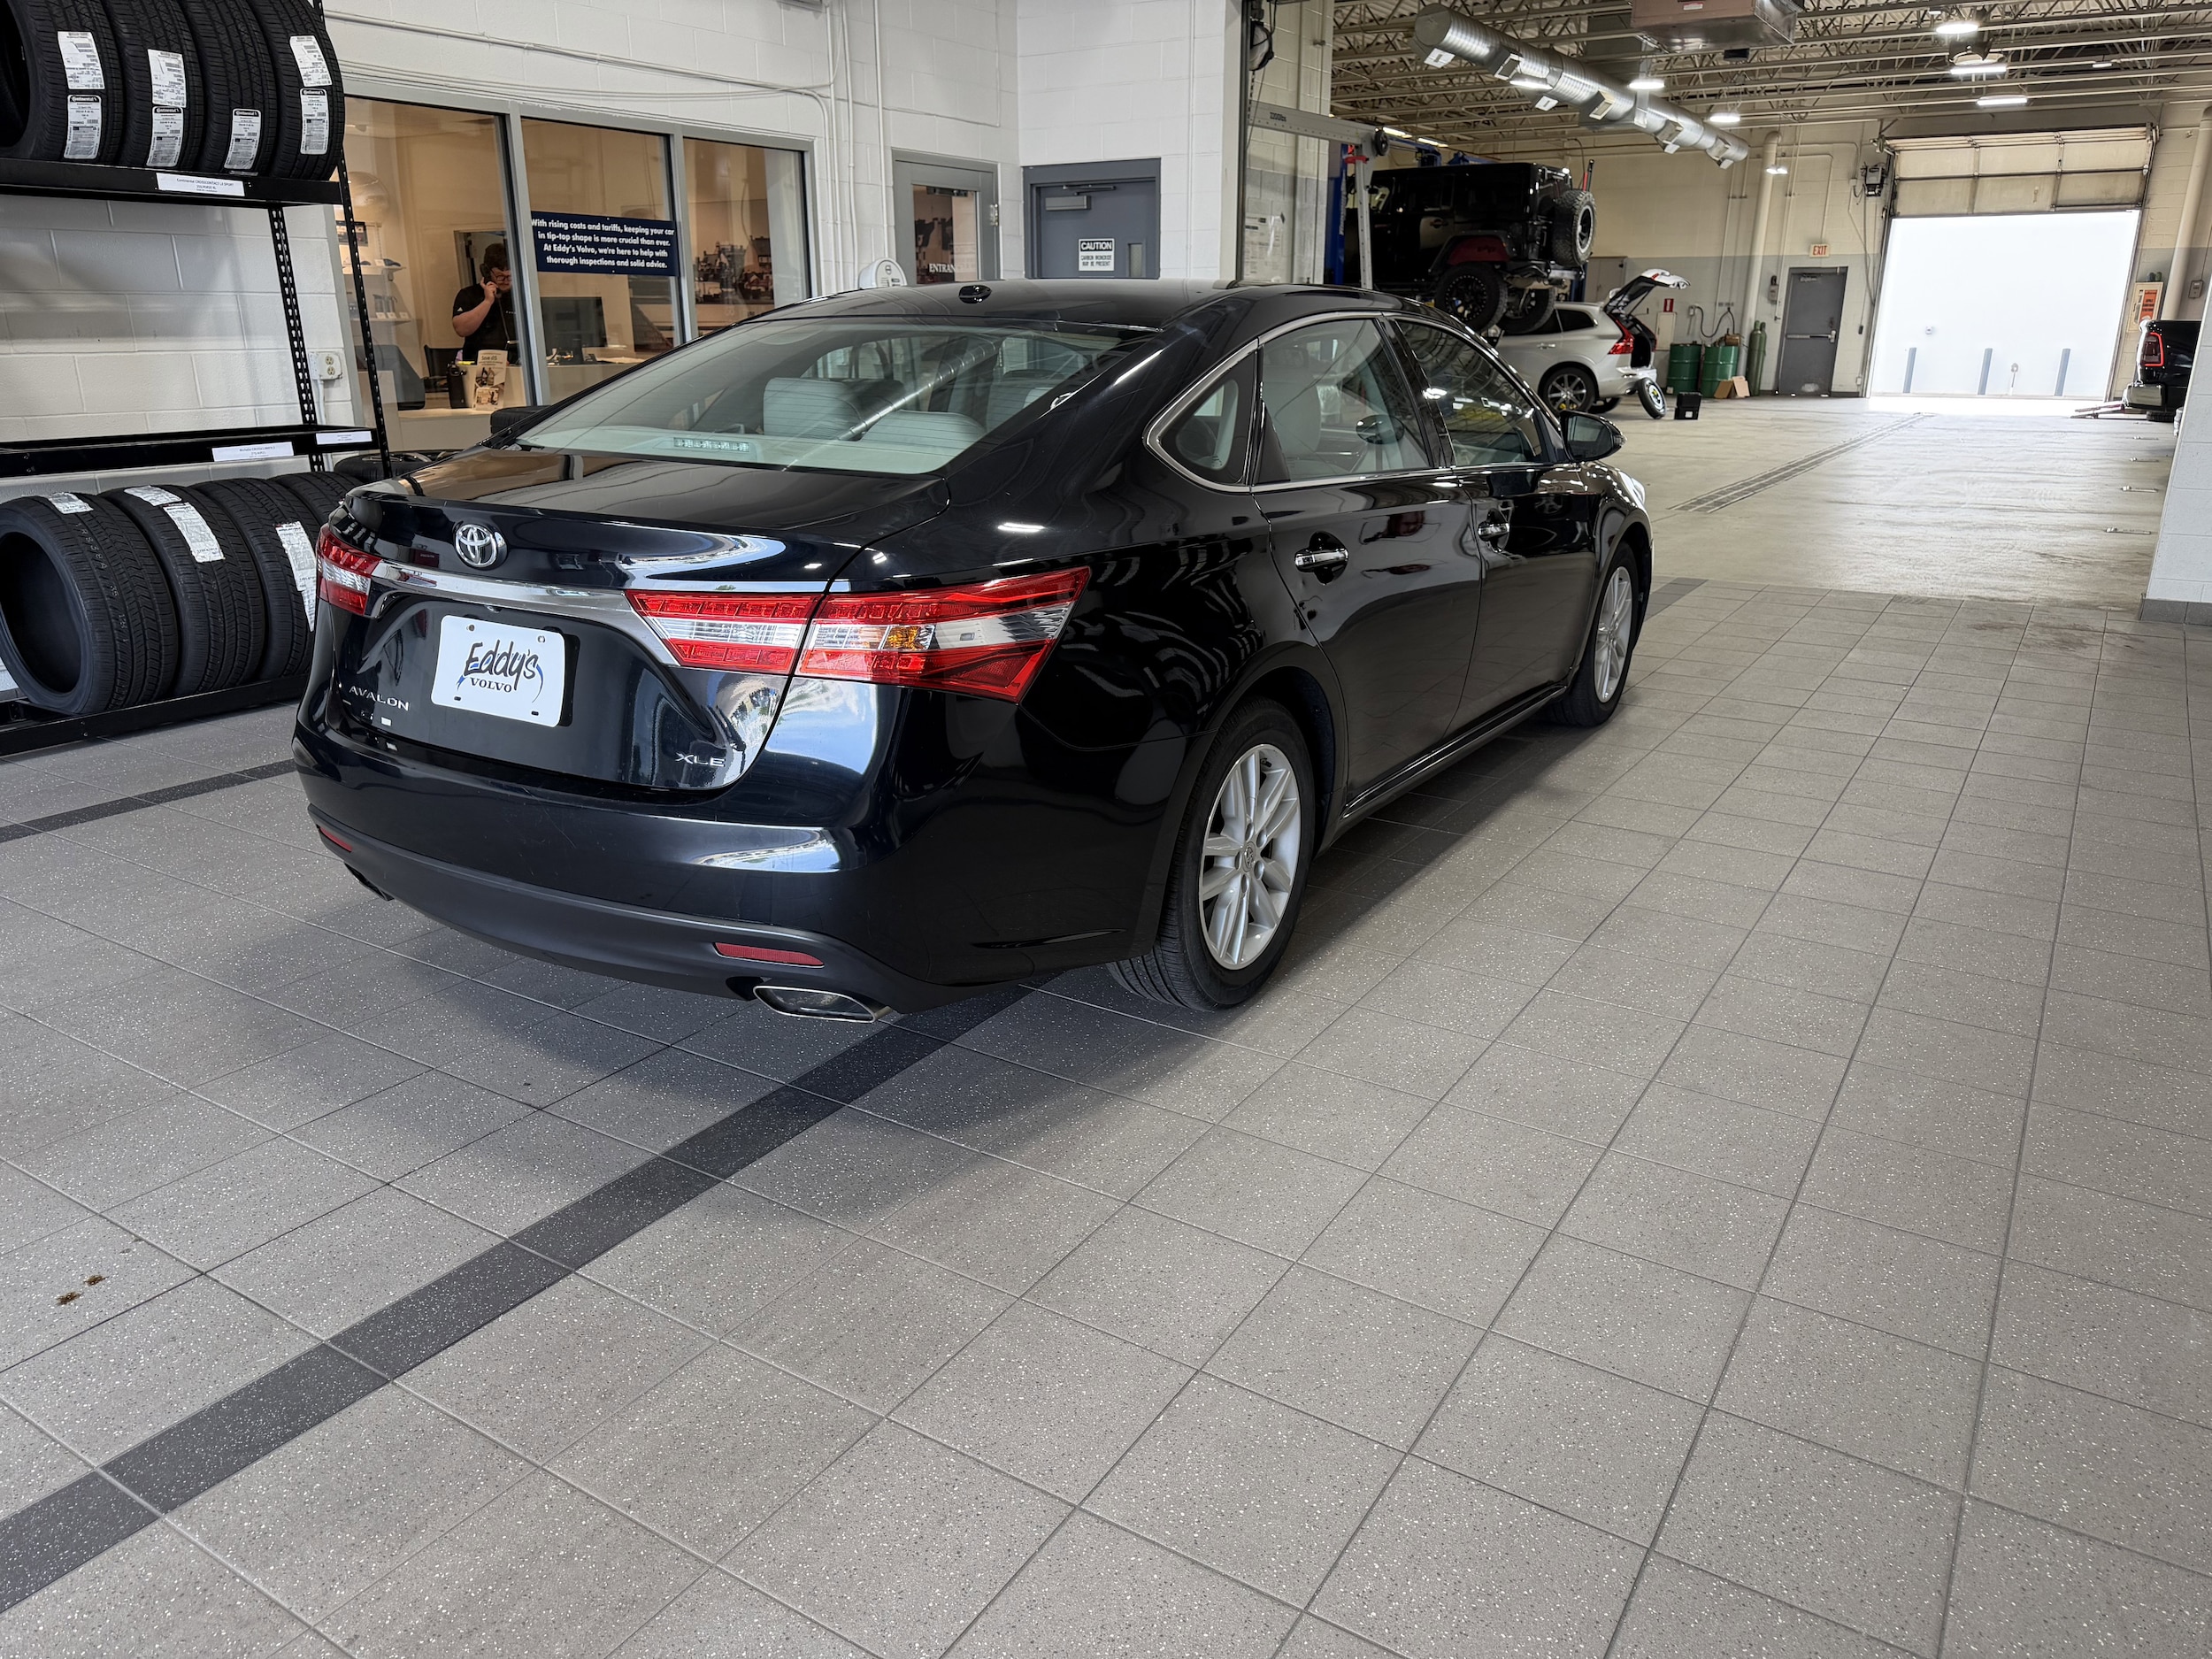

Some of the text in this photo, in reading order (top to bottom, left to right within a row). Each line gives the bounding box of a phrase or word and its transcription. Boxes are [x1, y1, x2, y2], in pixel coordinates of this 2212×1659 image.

[531, 219, 548, 227] With
[549, 219, 569, 230] rising
[602, 223, 623, 233] tariffs,
[624, 224, 649, 235] keeping
[547, 231, 571, 242] tip-top
[572, 233, 592, 243] shape
[552, 243, 575, 254] Eddy's
[576, 244, 597, 255] Volvo,
[616, 247, 632, 256] here
[640, 248, 654, 258] help
[1081, 242, 1112, 250] CAUTION
[1812, 245, 1828, 256] EXIT
[546, 255, 579, 265] thorough
[579, 256, 616, 266] inspections
[646, 259, 668, 268] advice.
[463, 639, 539, 691] Eddy's
[470, 677, 512, 693] VOLVO
[349, 685, 410, 711] AVALON
[674, 751, 726, 767] XLE
